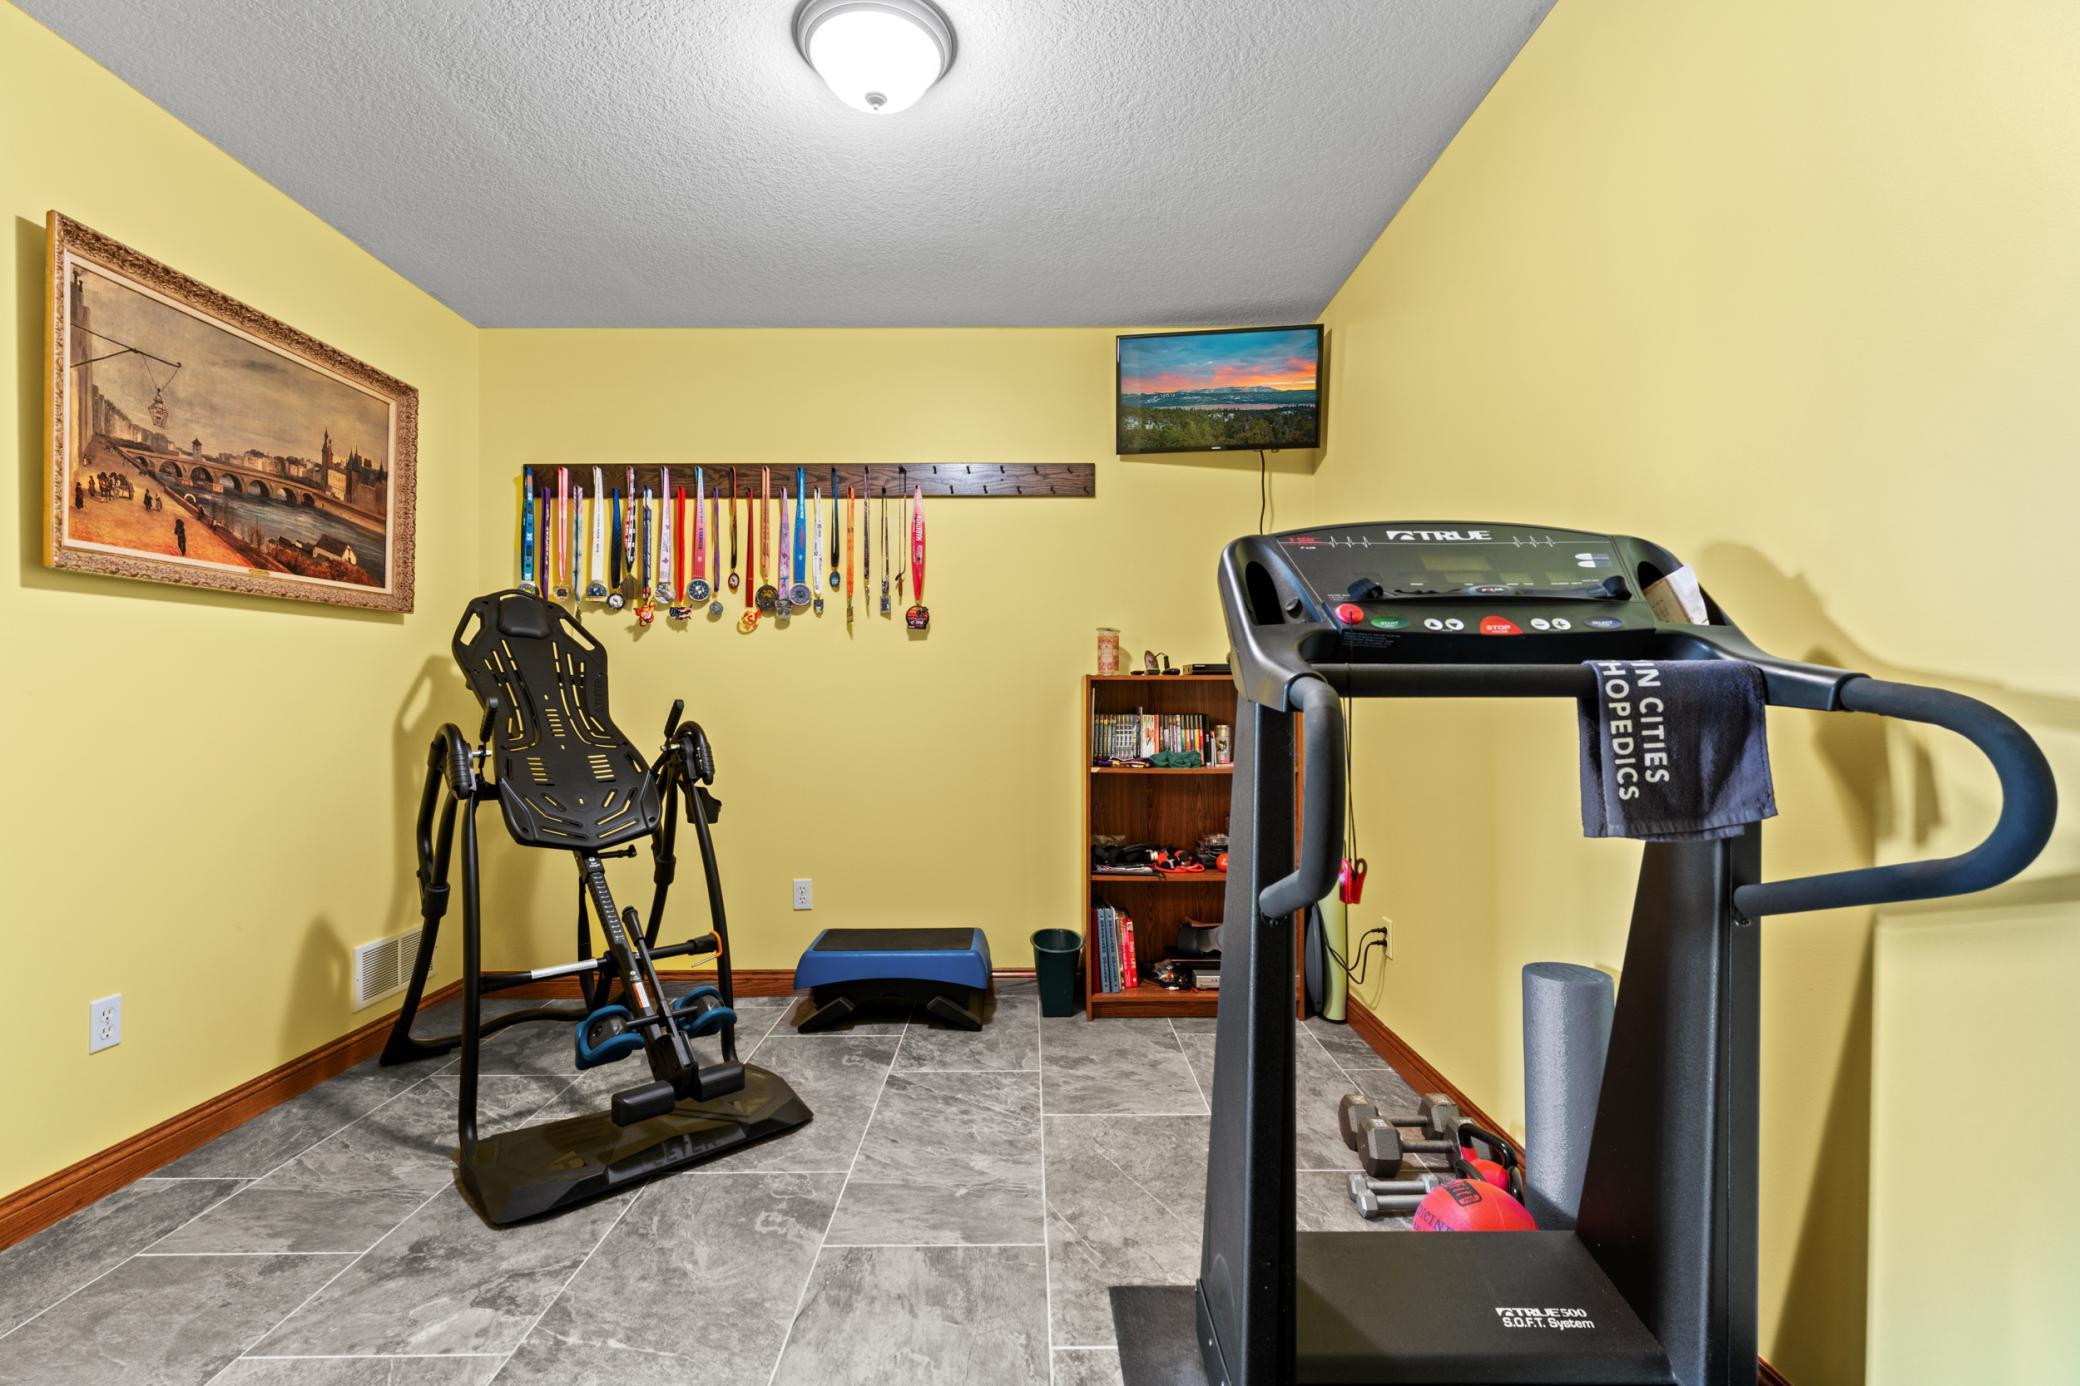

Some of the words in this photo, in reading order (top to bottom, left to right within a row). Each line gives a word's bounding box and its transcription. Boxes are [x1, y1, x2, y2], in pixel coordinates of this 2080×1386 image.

[1412, 530, 1493, 541] TRUE
[1598, 661, 1639, 801] HOPEDICS
[1639, 696, 1670, 783] CITIES
[1511, 1307, 1561, 1317] TRUE
[1560, 1308, 1588, 1318] 500
[1502, 1317, 1547, 1328] S.O.F.T.
[1547, 1317, 1596, 1331] System
